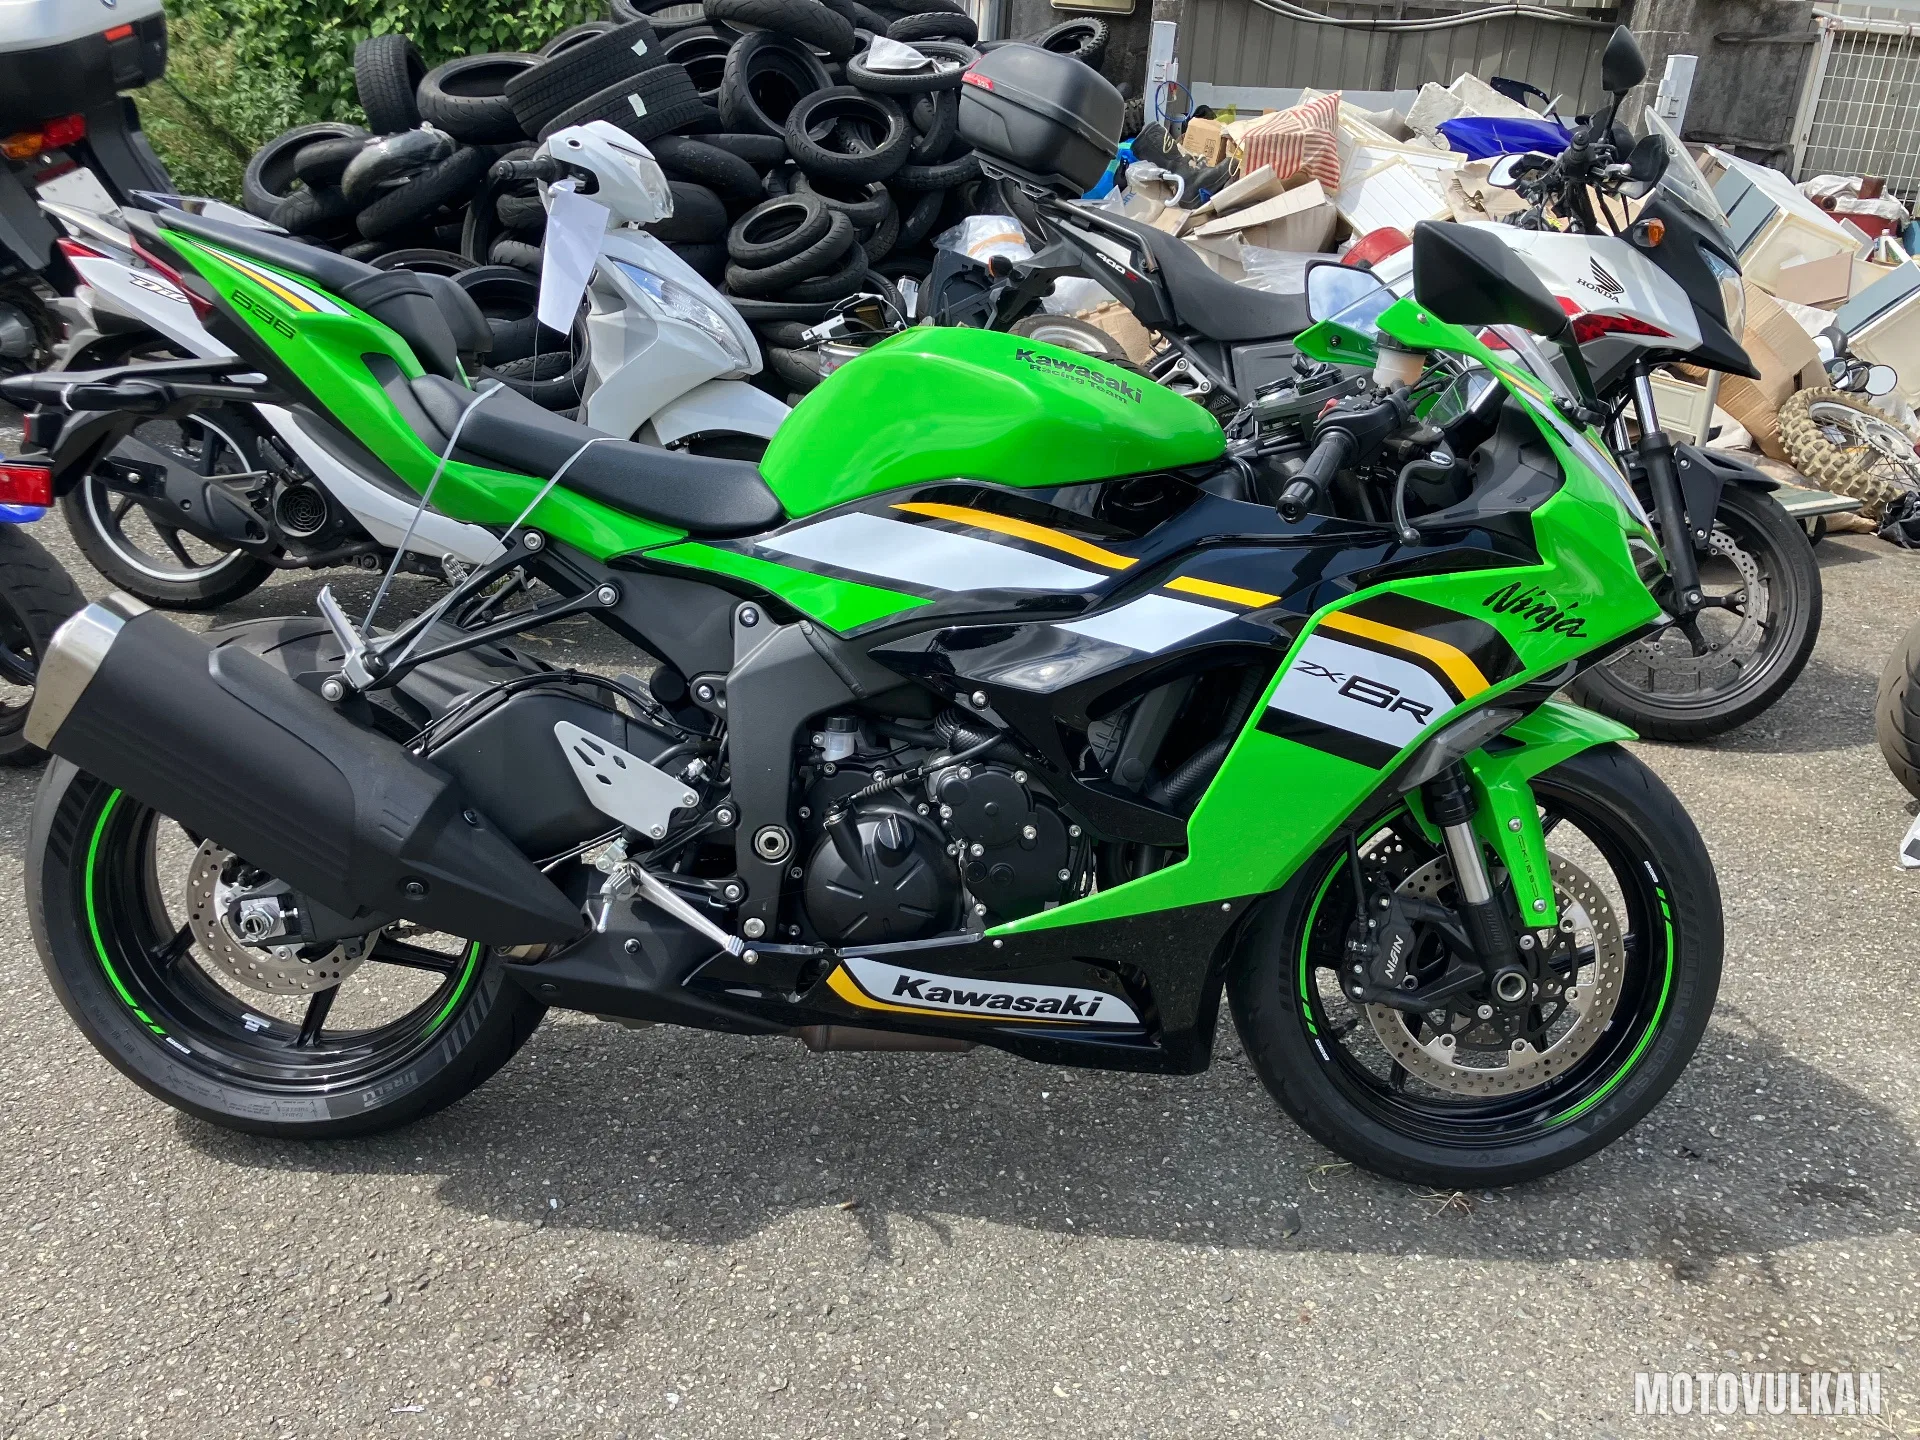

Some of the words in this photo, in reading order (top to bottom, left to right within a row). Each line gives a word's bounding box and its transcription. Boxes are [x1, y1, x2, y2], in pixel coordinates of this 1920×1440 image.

[231, 289, 297, 340] 636
[1576, 278, 1620, 304] HONDA
[1016, 348, 1142, 404] Kawasaki
[1030, 364, 1084, 385] Racing
[1088, 380, 1128, 404] Team
[1482, 581, 1587, 637] Ninja
[1293, 660, 1434, 726] ZX-6R
[892, 984, 1103, 1017] Kawasaki
[363, 1070, 419, 1107] PIRELLI
[1625, 1036, 1675, 1099] ROSSO
